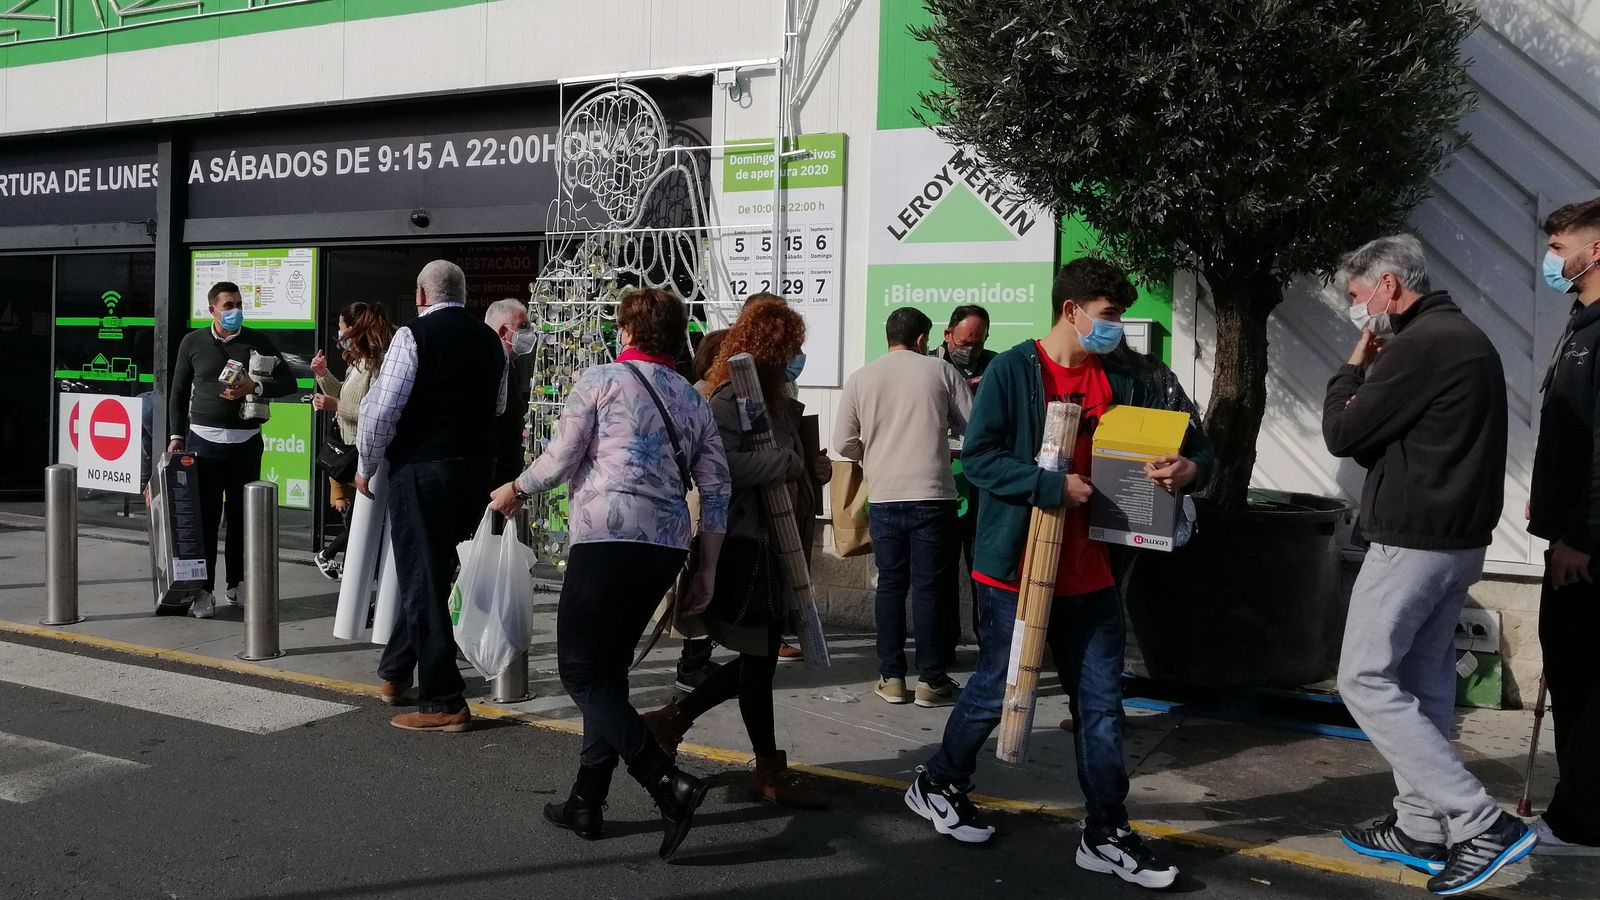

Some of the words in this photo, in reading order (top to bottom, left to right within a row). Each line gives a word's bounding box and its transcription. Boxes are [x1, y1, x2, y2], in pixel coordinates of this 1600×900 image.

[730, 152, 776, 166] Domingo
[0, 171, 60, 197] RTURA
[64, 168, 90, 193] DE
[97, 163, 158, 191] LUNES
[188, 159, 204, 184] A
[210, 150, 328, 183] SÁBADOS
[336, 147, 369, 175] DE
[378, 142, 432, 172] 9:15
[439, 141, 459, 169] A
[736, 169, 749, 180] de
[751, 166, 798, 181] aperura
[801, 165, 829, 176] 2020
[738, 205, 750, 215] De
[789, 202, 816, 212] 22:00
[819, 200, 825, 211] h
[886, 164, 954, 241] LEROY
[735, 237, 745, 253] 5
[761, 236, 771, 252] 5
[784, 235, 803, 251] 15
[816, 234, 826, 250] 6
[729, 280, 748, 295] 12
[782, 279, 804, 295] 29
[815, 278, 826, 294] 7
[884, 282, 1035, 307] ¡Bienvenidos!
[262, 433, 305, 454] trada
[88, 468, 101, 481] NO
[102, 470, 131, 484] PASAR
